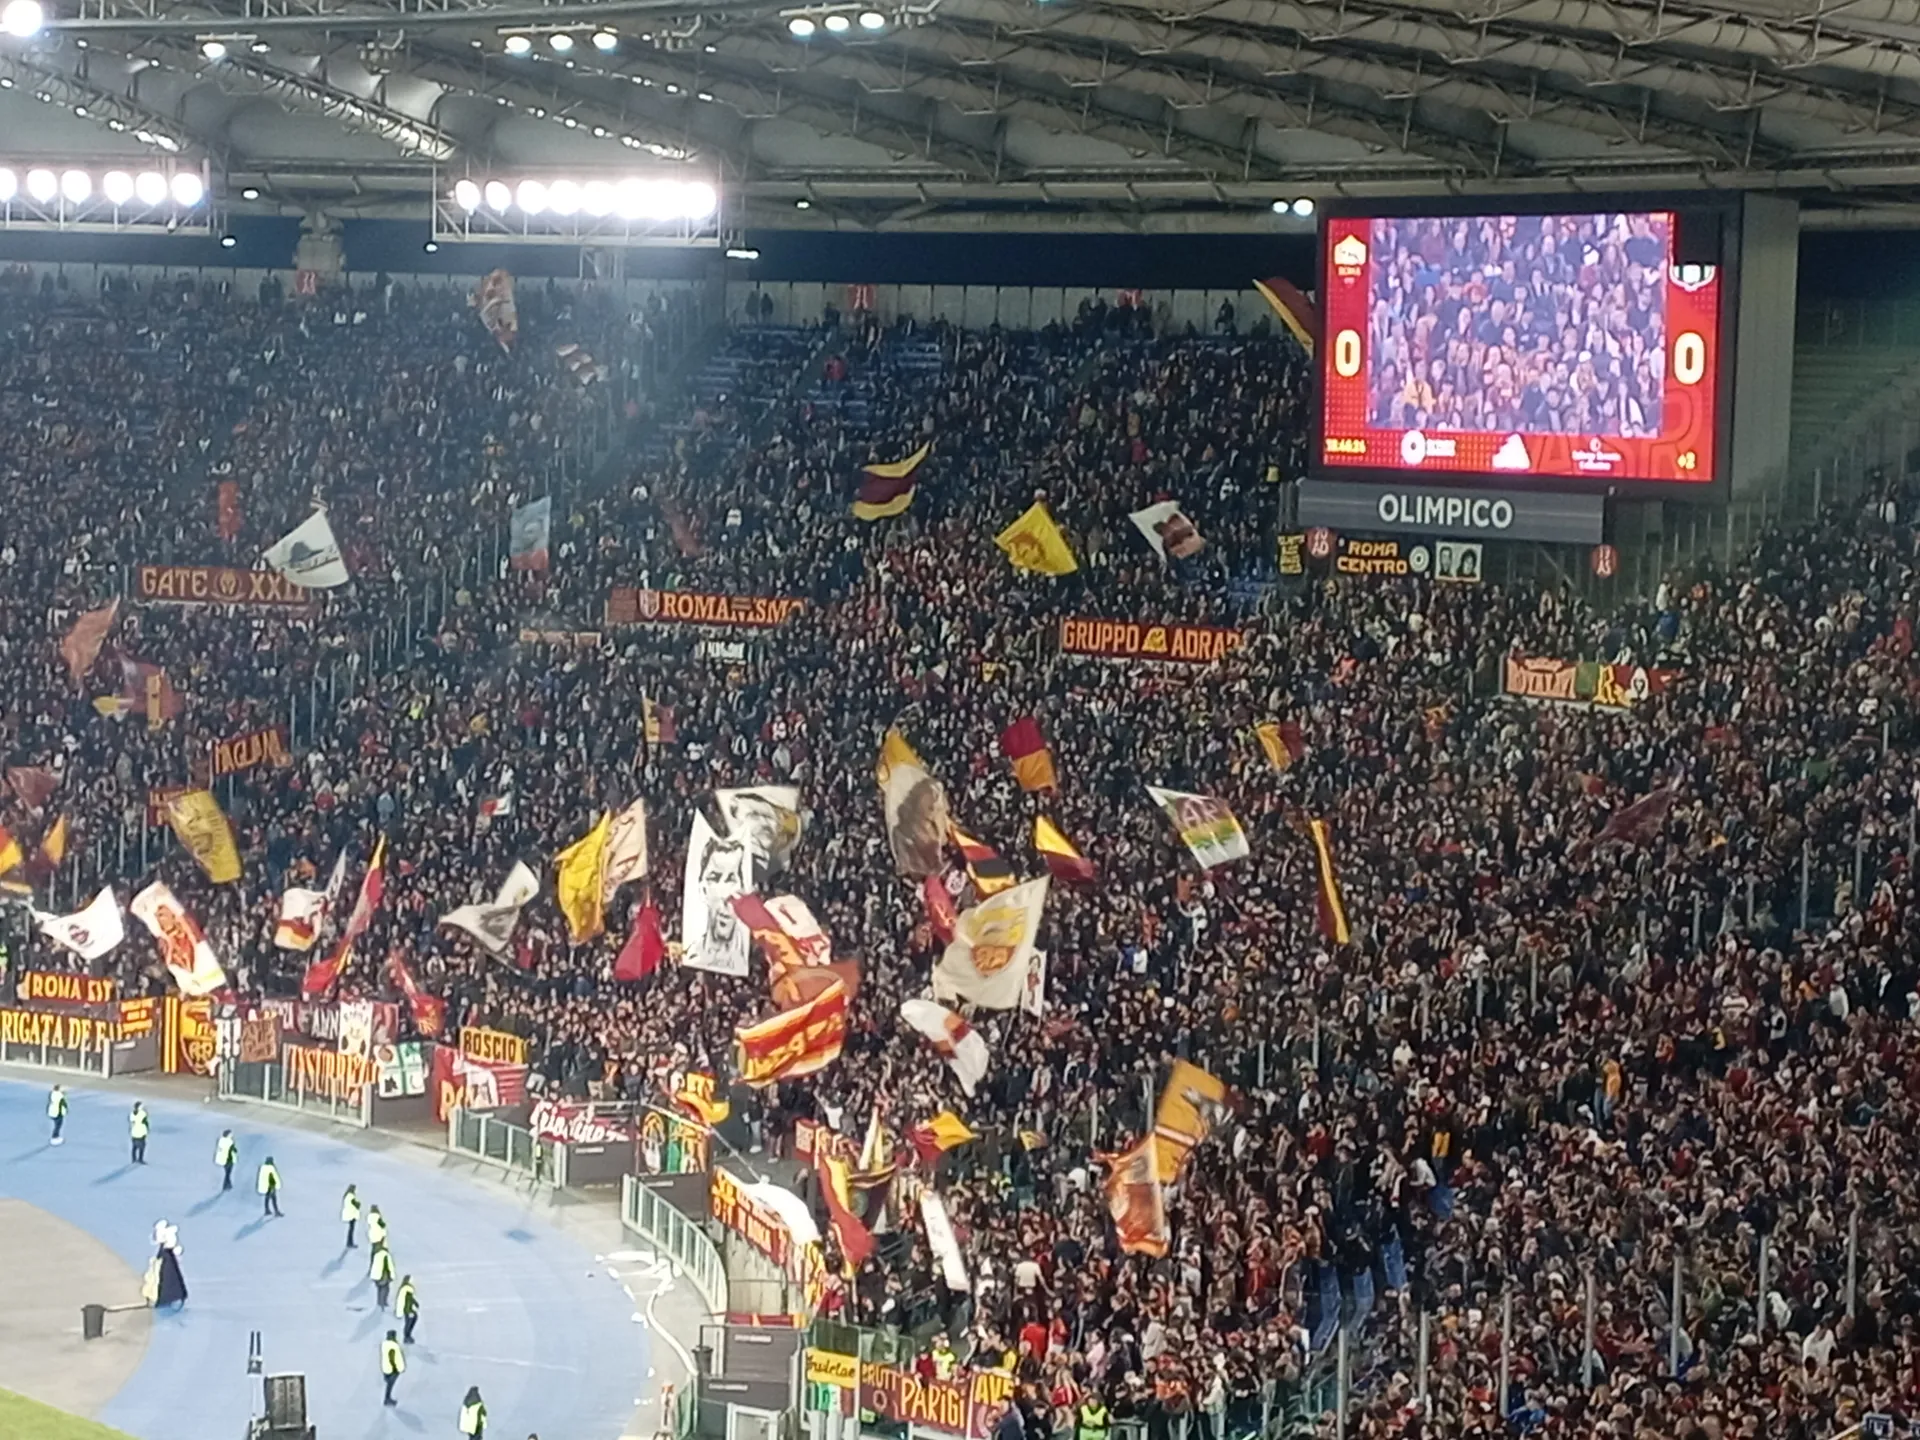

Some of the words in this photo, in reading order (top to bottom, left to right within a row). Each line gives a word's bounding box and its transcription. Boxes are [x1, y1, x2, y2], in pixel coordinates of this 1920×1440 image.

[1335, 329, 1360, 377] 0
[1674, 332, 1704, 384] 0
[1379, 493, 1513, 529] OLIMPICO
[1336, 556, 1408, 575] CENTRO
[1347, 540, 1399, 558] ROMA
[141, 567, 208, 598] GATE
[1063, 620, 1140, 653] GRUPPO
[32, 973, 82, 1000] ROMA
[1, 1009, 64, 1049] RIGATA
